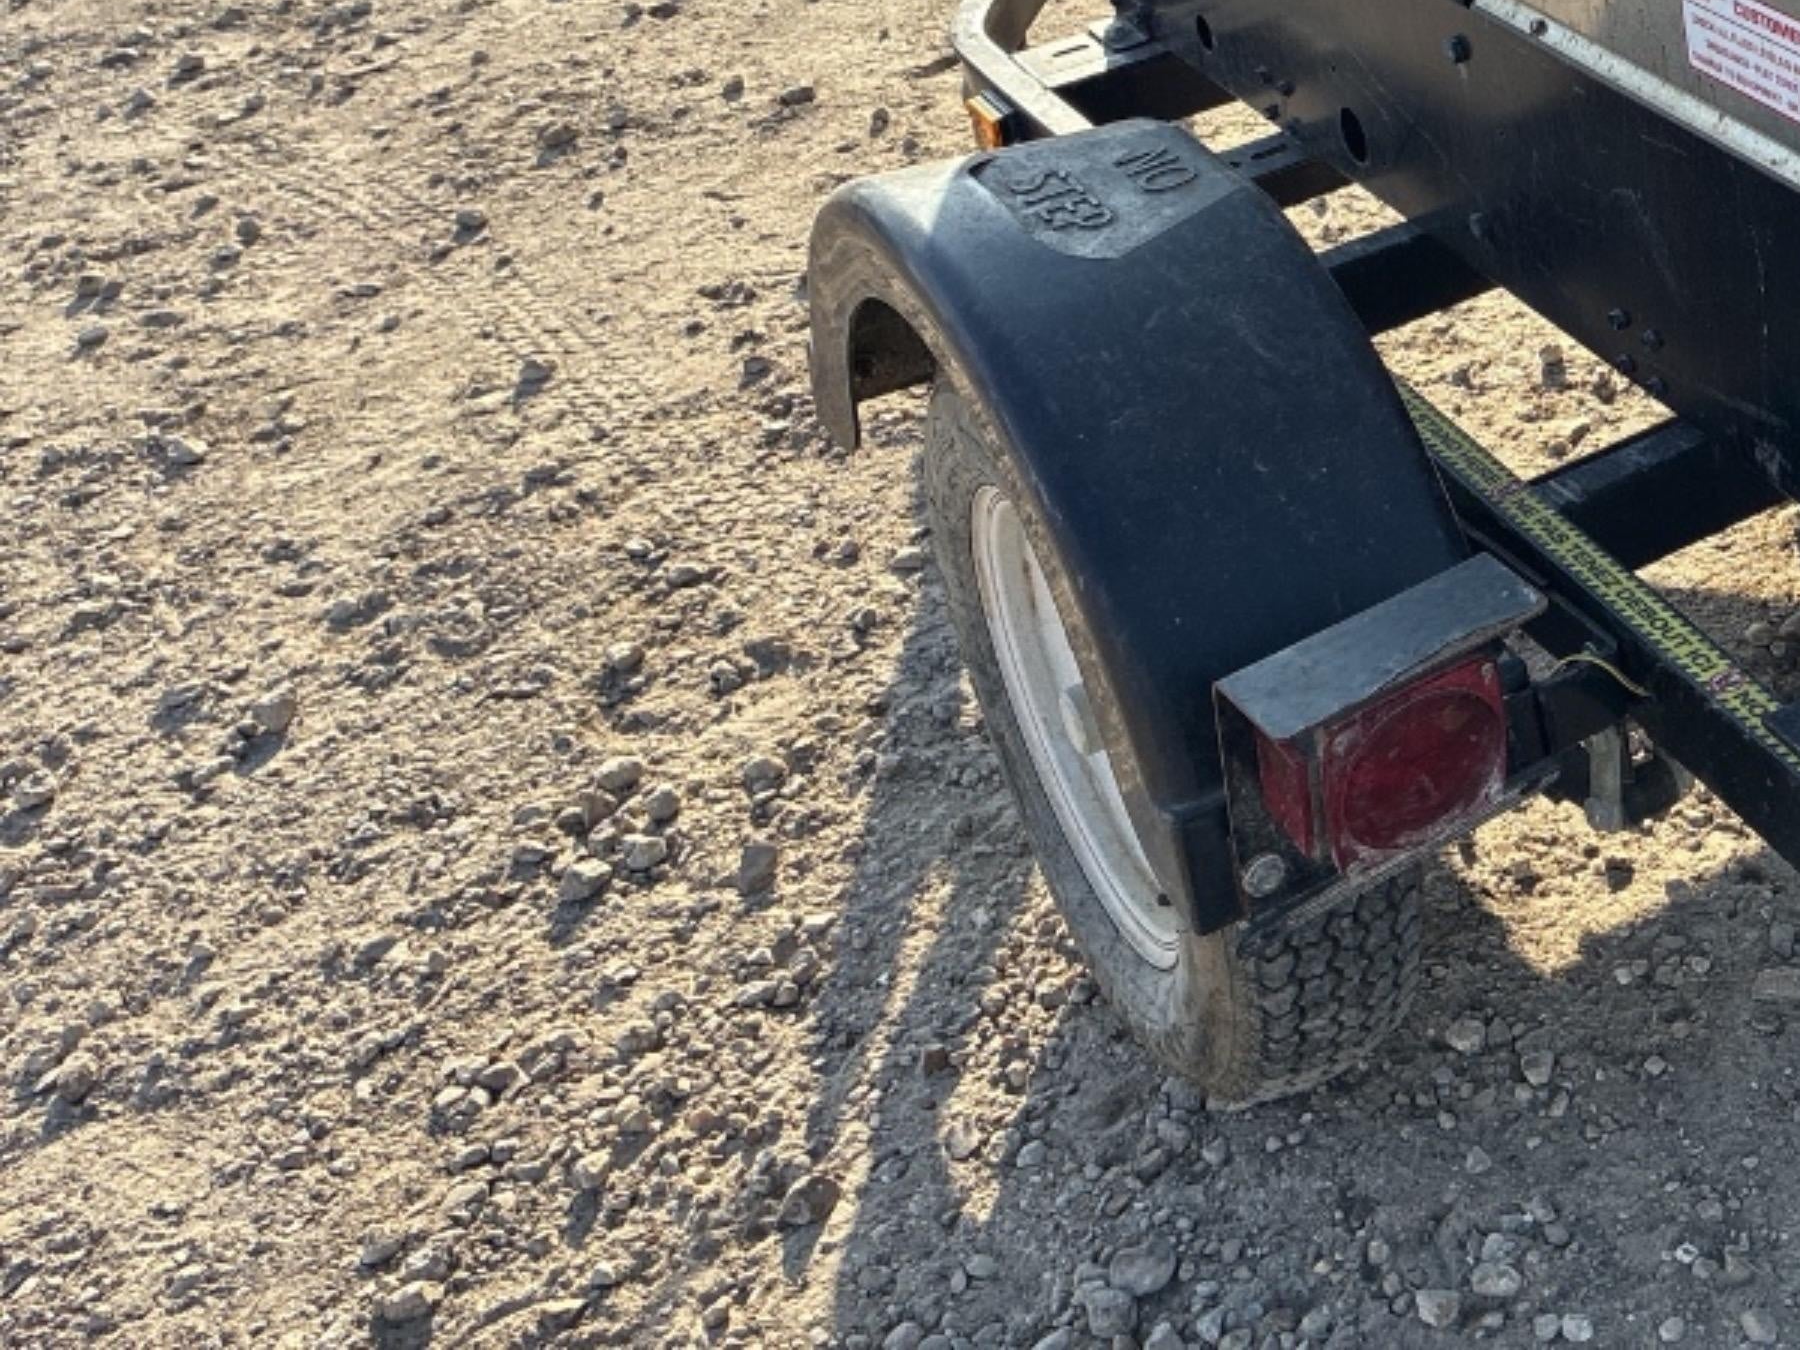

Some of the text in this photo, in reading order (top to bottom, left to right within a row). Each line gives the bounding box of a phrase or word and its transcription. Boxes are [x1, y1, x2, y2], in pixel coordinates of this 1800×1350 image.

[1007, 169, 1119, 232] STEP
[1113, 147, 1199, 193] NO
[1616, 586, 1693, 654] DEBOUT
